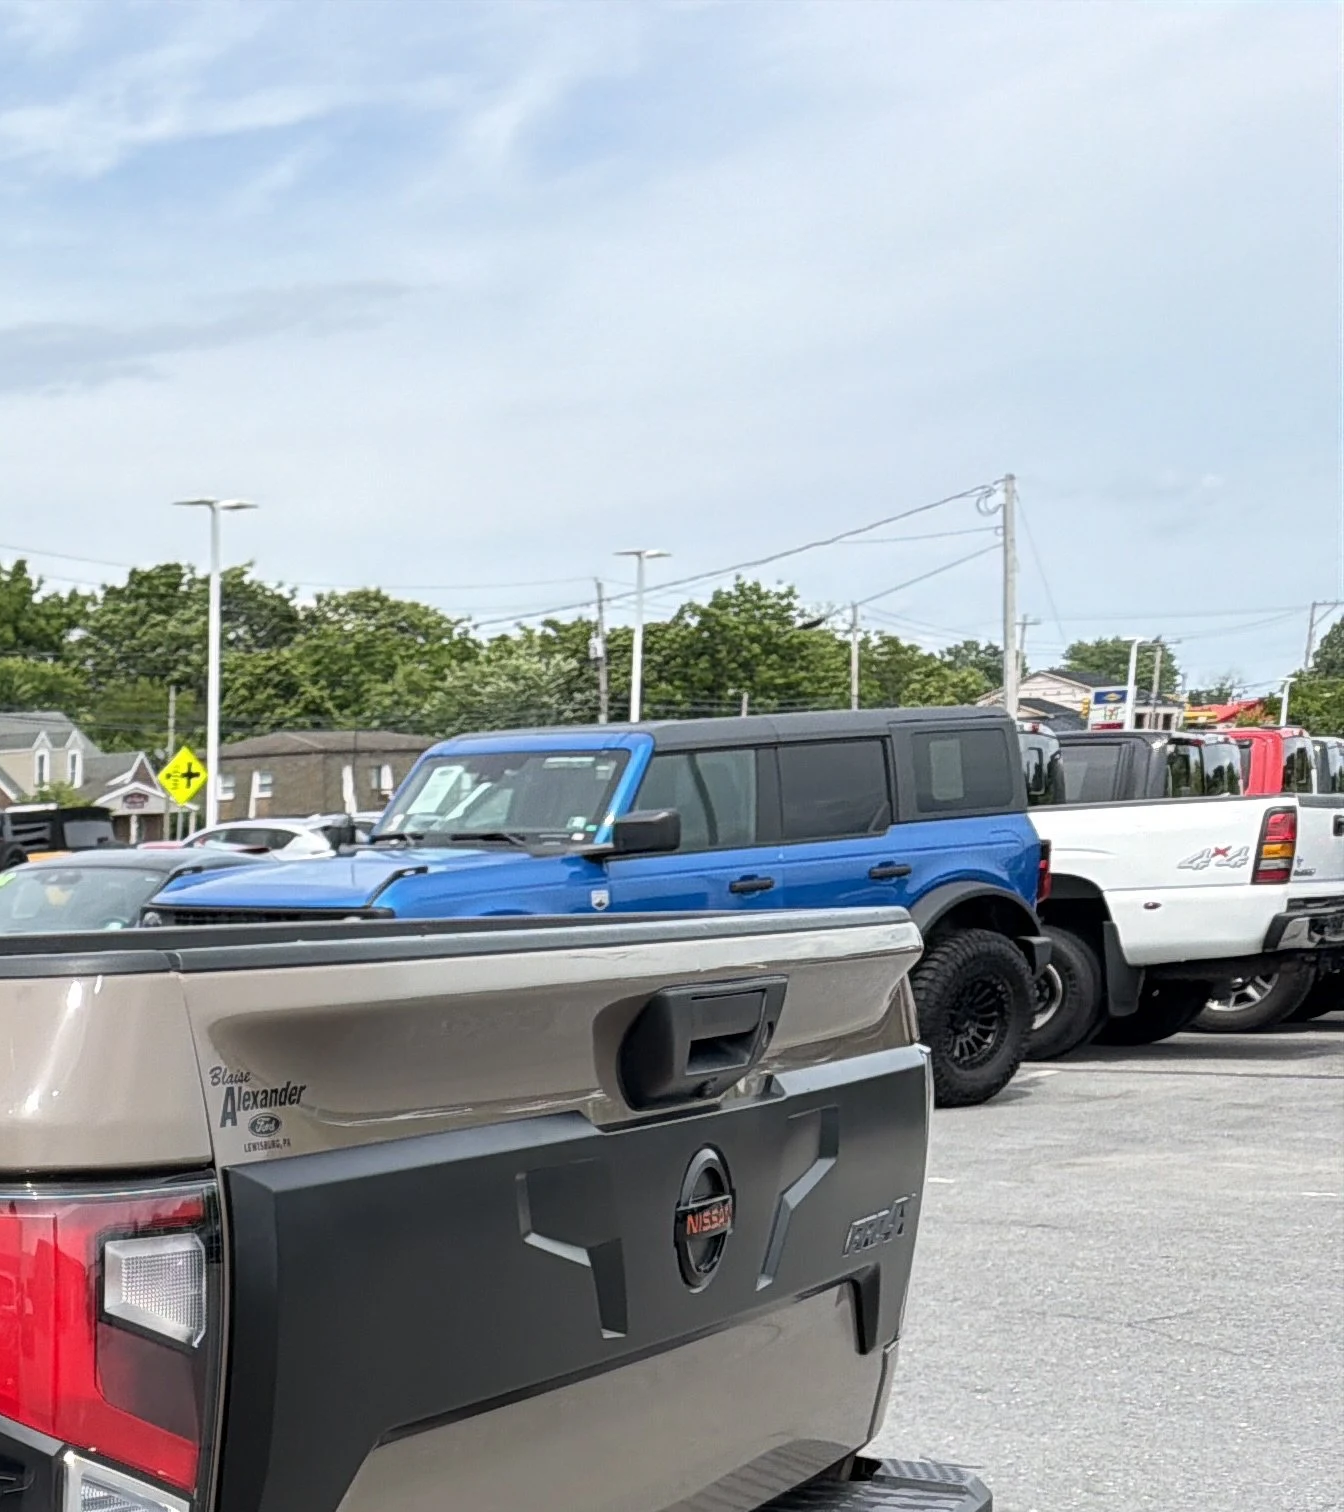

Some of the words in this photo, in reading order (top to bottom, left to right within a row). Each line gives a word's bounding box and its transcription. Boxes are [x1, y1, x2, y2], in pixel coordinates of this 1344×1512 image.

[209, 1066, 252, 1086] Blaise
[219, 1081, 307, 1128] Alexander
[685, 1201, 733, 1235] NISSAN
